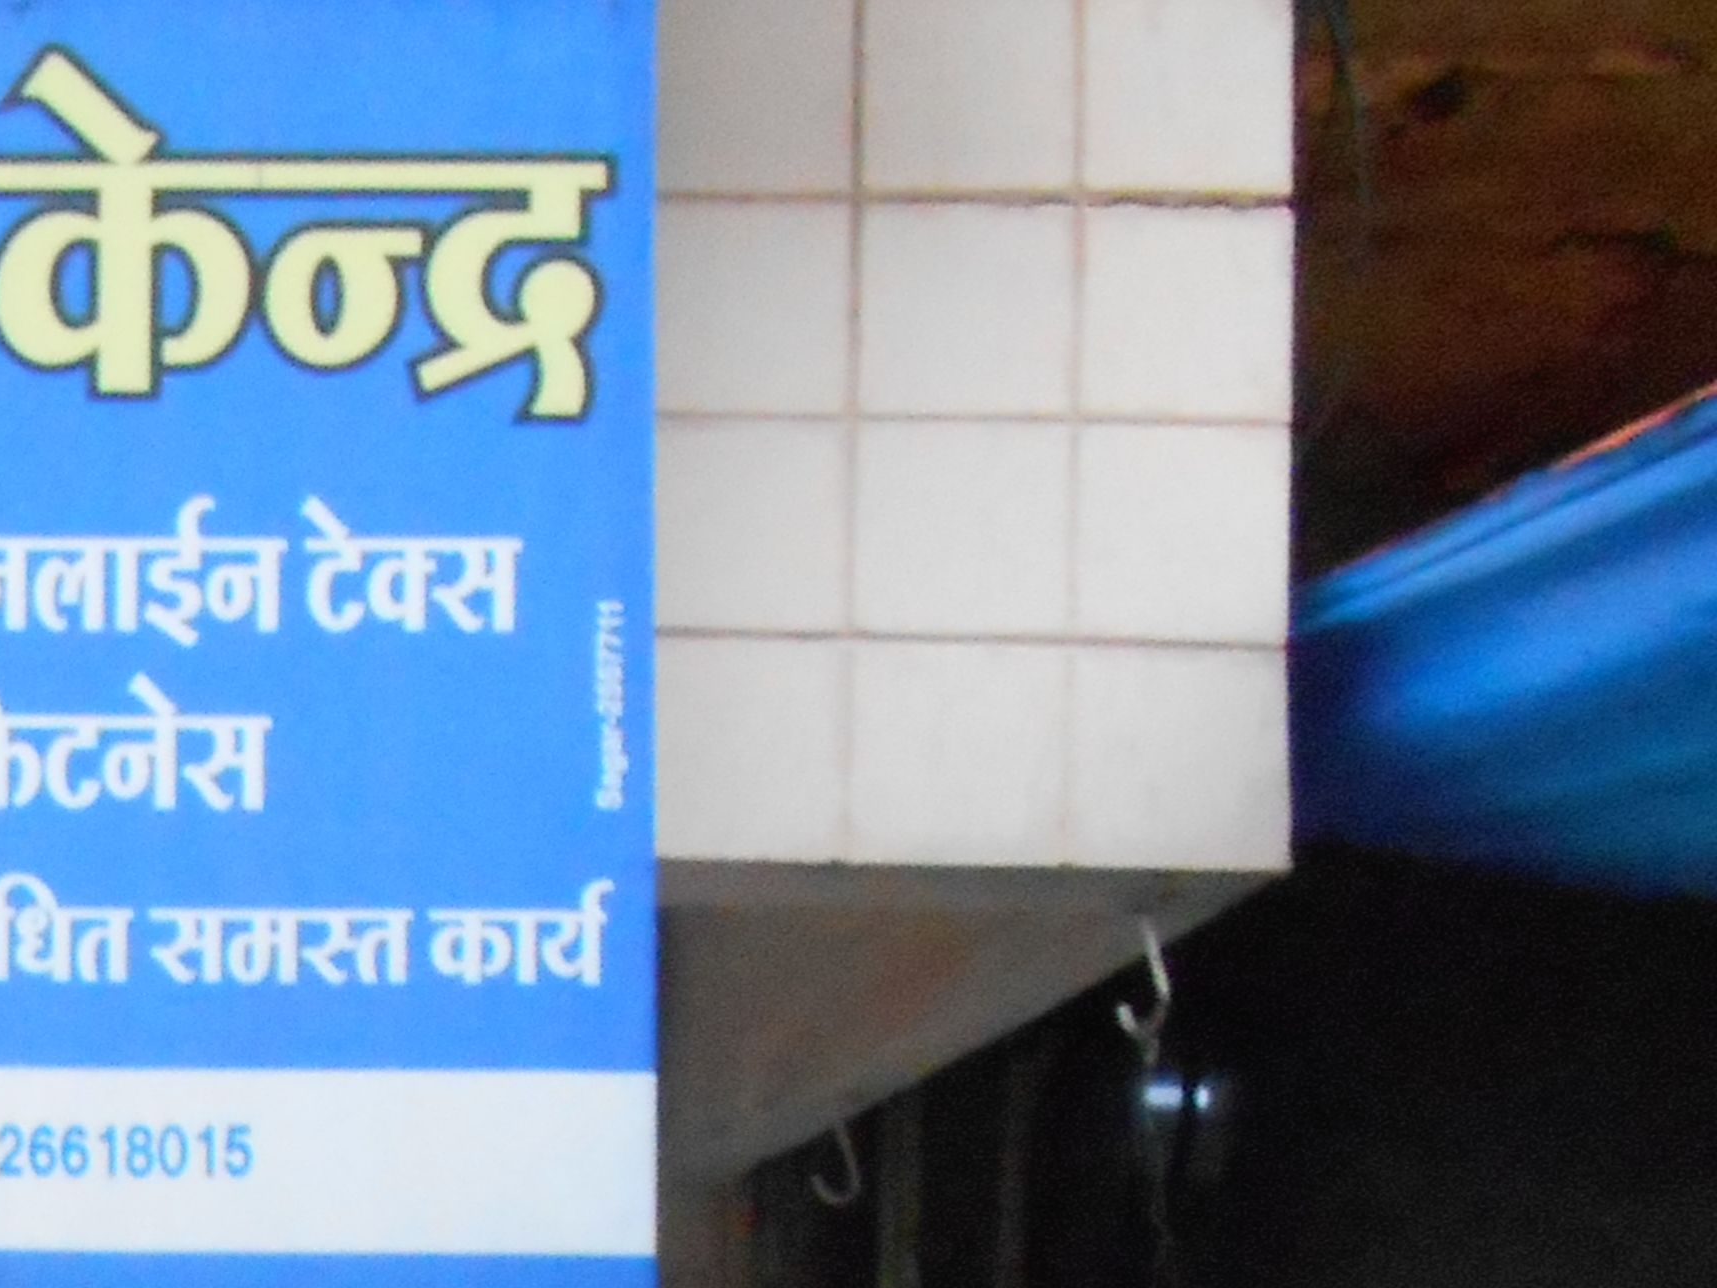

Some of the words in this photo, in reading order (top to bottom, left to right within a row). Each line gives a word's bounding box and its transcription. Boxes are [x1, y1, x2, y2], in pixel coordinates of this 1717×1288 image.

[304, 497, 523, 632] टेक्स
[152, 908, 413, 983] समस्त
[432, 880, 612, 984] कार्य
